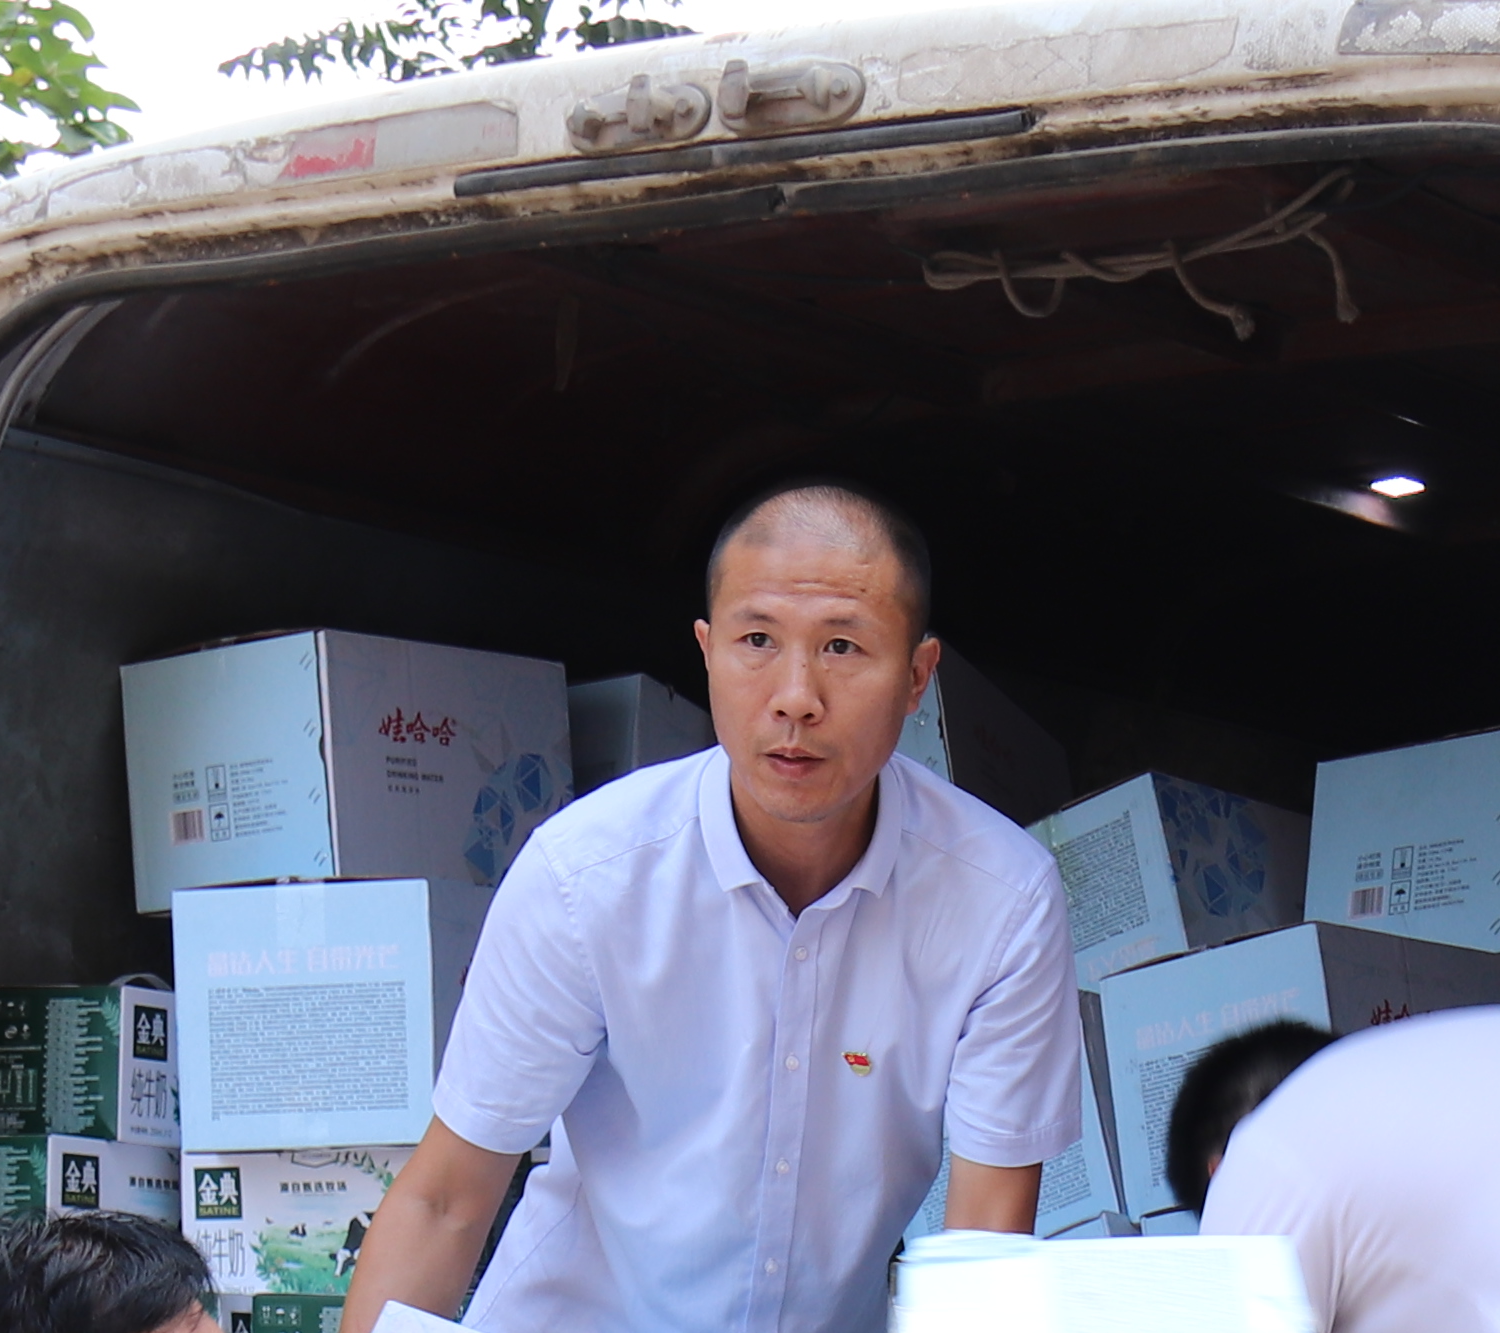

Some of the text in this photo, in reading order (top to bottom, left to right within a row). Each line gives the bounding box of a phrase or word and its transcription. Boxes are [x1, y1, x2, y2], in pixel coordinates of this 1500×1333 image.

[379, 706, 457, 746] 娃哈哈
[136, 1012, 166, 1047] 金典
[131, 1068, 168, 1119] 纯牛奶
[64, 1160, 98, 1193] 金典
[199, 1171, 238, 1206] 金典
[199, 1206, 239, 1217] SATINE
[196, 1228, 246, 1279] 纯牛奶
